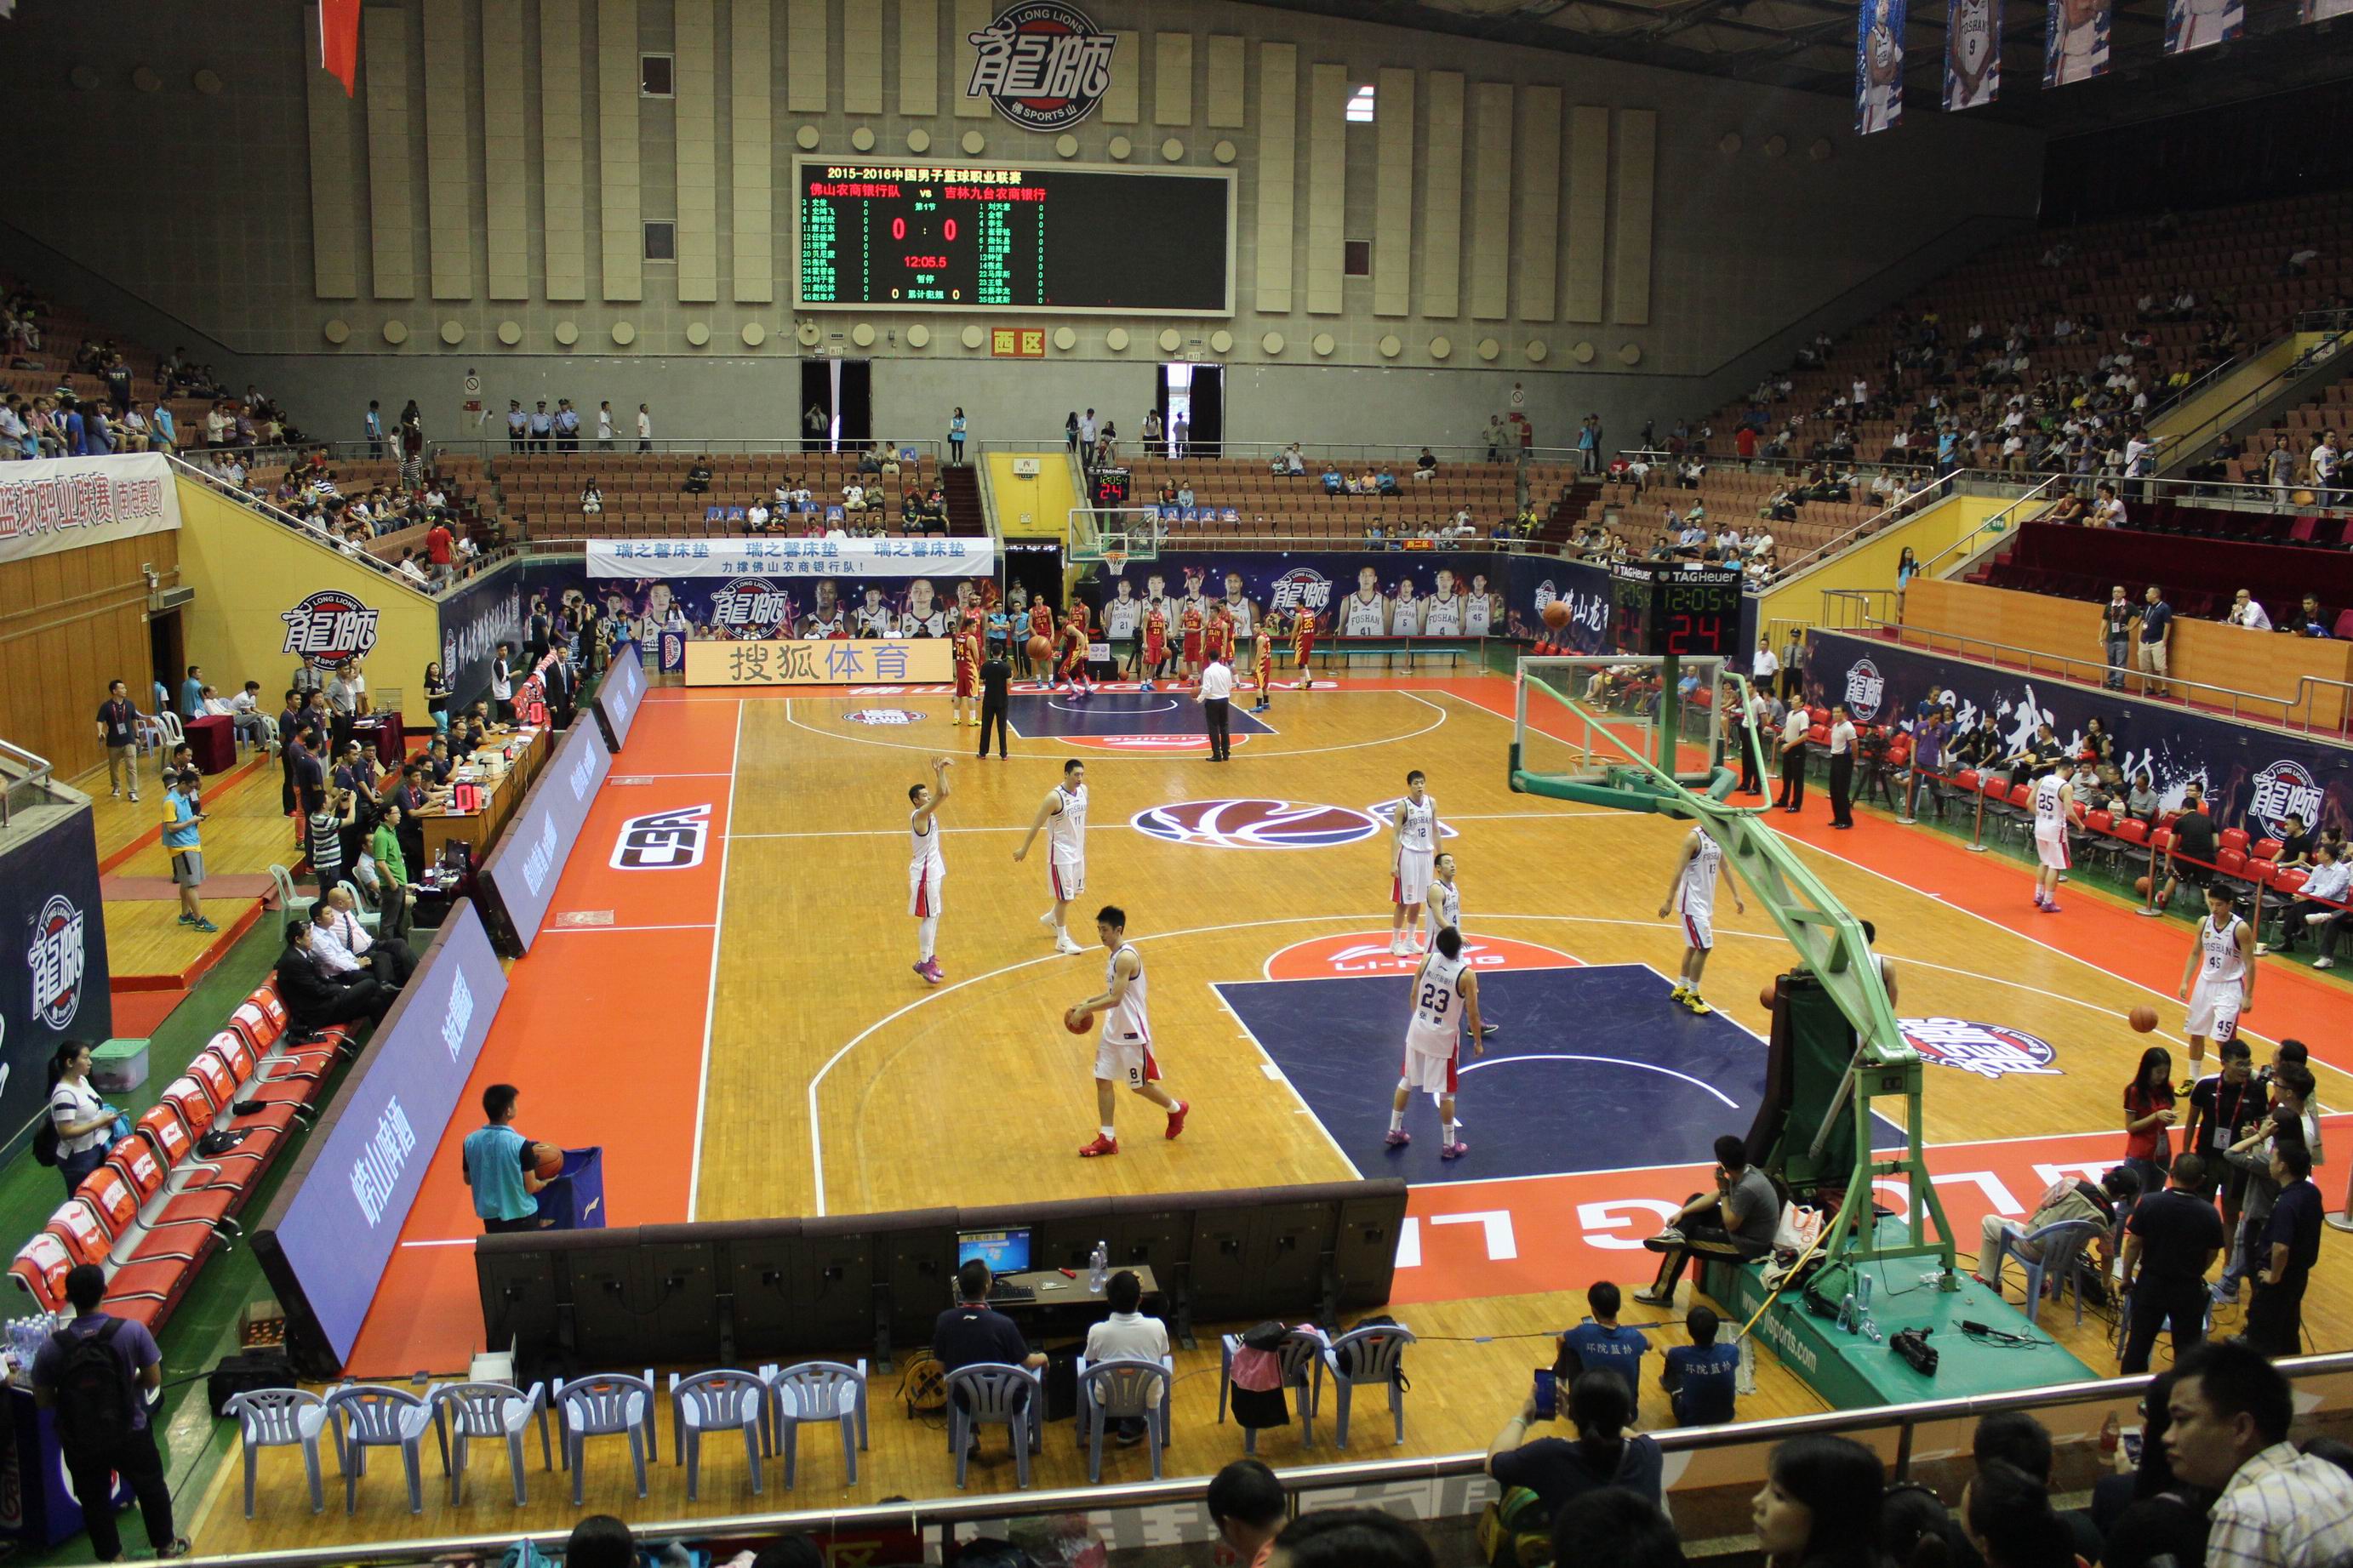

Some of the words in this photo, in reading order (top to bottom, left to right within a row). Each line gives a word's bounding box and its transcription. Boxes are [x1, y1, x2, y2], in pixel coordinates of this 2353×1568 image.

[1018, 9, 1050, 24] LONG
[1053, 10, 1084, 34] LIONS
[1969, 39, 1976, 55] 9
[1023, 107, 1065, 121] SPORTS
[1066, 103, 1077, 116] 山
[827, 167, 1022, 185] 2015-2016中国男子篮球职业联赛
[810, 182, 900, 198] 佛山农商银行队
[945, 186, 1046, 202] 吉林九台农商银行
[915, 202, 936, 211] 第1节
[893, 218, 905, 240] 0
[944, 219, 957, 241] 0
[904, 256, 947, 268] 12:05.5
[892, 288, 900, 299] 0
[908, 289, 944, 299] 累计犯规
[952, 289, 960, 299] 0
[994, 331, 1042, 354] 西区
[1099, 484, 1122, 500] 24
[615, 543, 710, 558] 瑞之馨床垫
[745, 542, 839, 557] 瑞之馨床垫
[873, 541, 966, 557] 瑞之馨床垫
[312, 596, 334, 607] LONG
[336, 596, 357, 611] LIONS
[1120, 621, 1128, 630] 21
[1304, 619, 1313, 629] 25
[1668, 614, 1721, 654] 24
[957, 643, 964, 654] 14
[729, 642, 911, 682] 搜狐体育
[2038, 793, 2054, 812] 25
[608, 804, 711, 870] CBA
[1418, 829, 1426, 837] 12
[44, 908, 59, 926] LONG
[1452, 915, 1457, 925] 4
[1334, 955, 1505, 972] LI-NG
[2210, 956, 2221, 968] 45
[1421, 984, 1450, 1013] 23
[2218, 1021, 2232, 1033] 45
[1130, 1068, 1138, 1079] 8
[350, 1095, 416, 1229] 崂山啤酒
